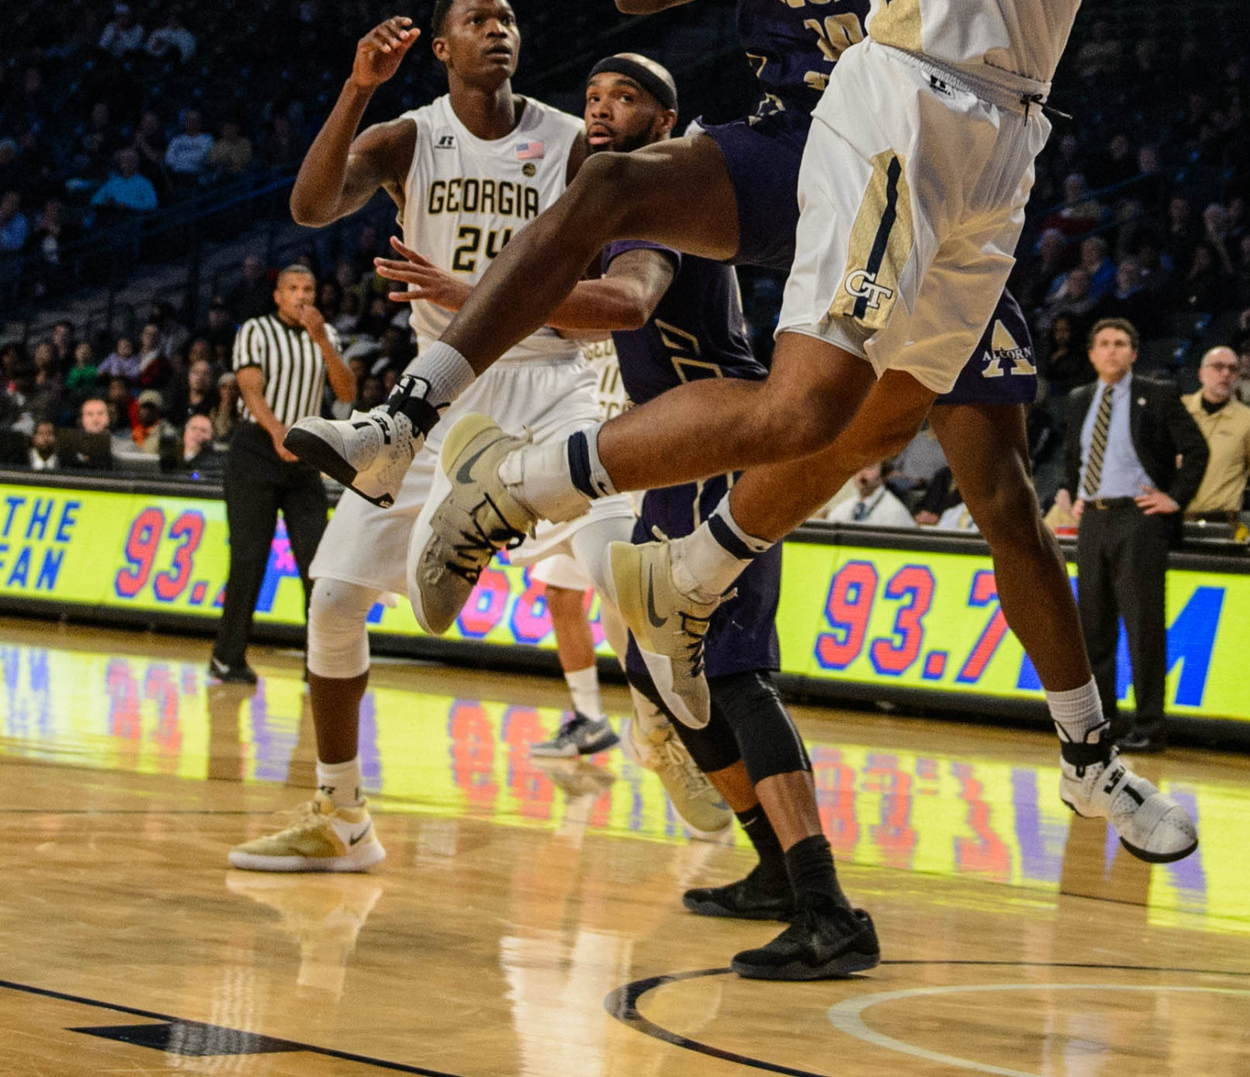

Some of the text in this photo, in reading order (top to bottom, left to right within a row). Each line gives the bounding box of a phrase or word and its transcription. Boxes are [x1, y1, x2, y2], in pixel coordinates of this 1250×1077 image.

[428, 178, 539, 220] GEORGIA
[452, 226, 514, 272] 24
[2, 495, 82, 543] THE
[814, 559, 1010, 684] 93.7
